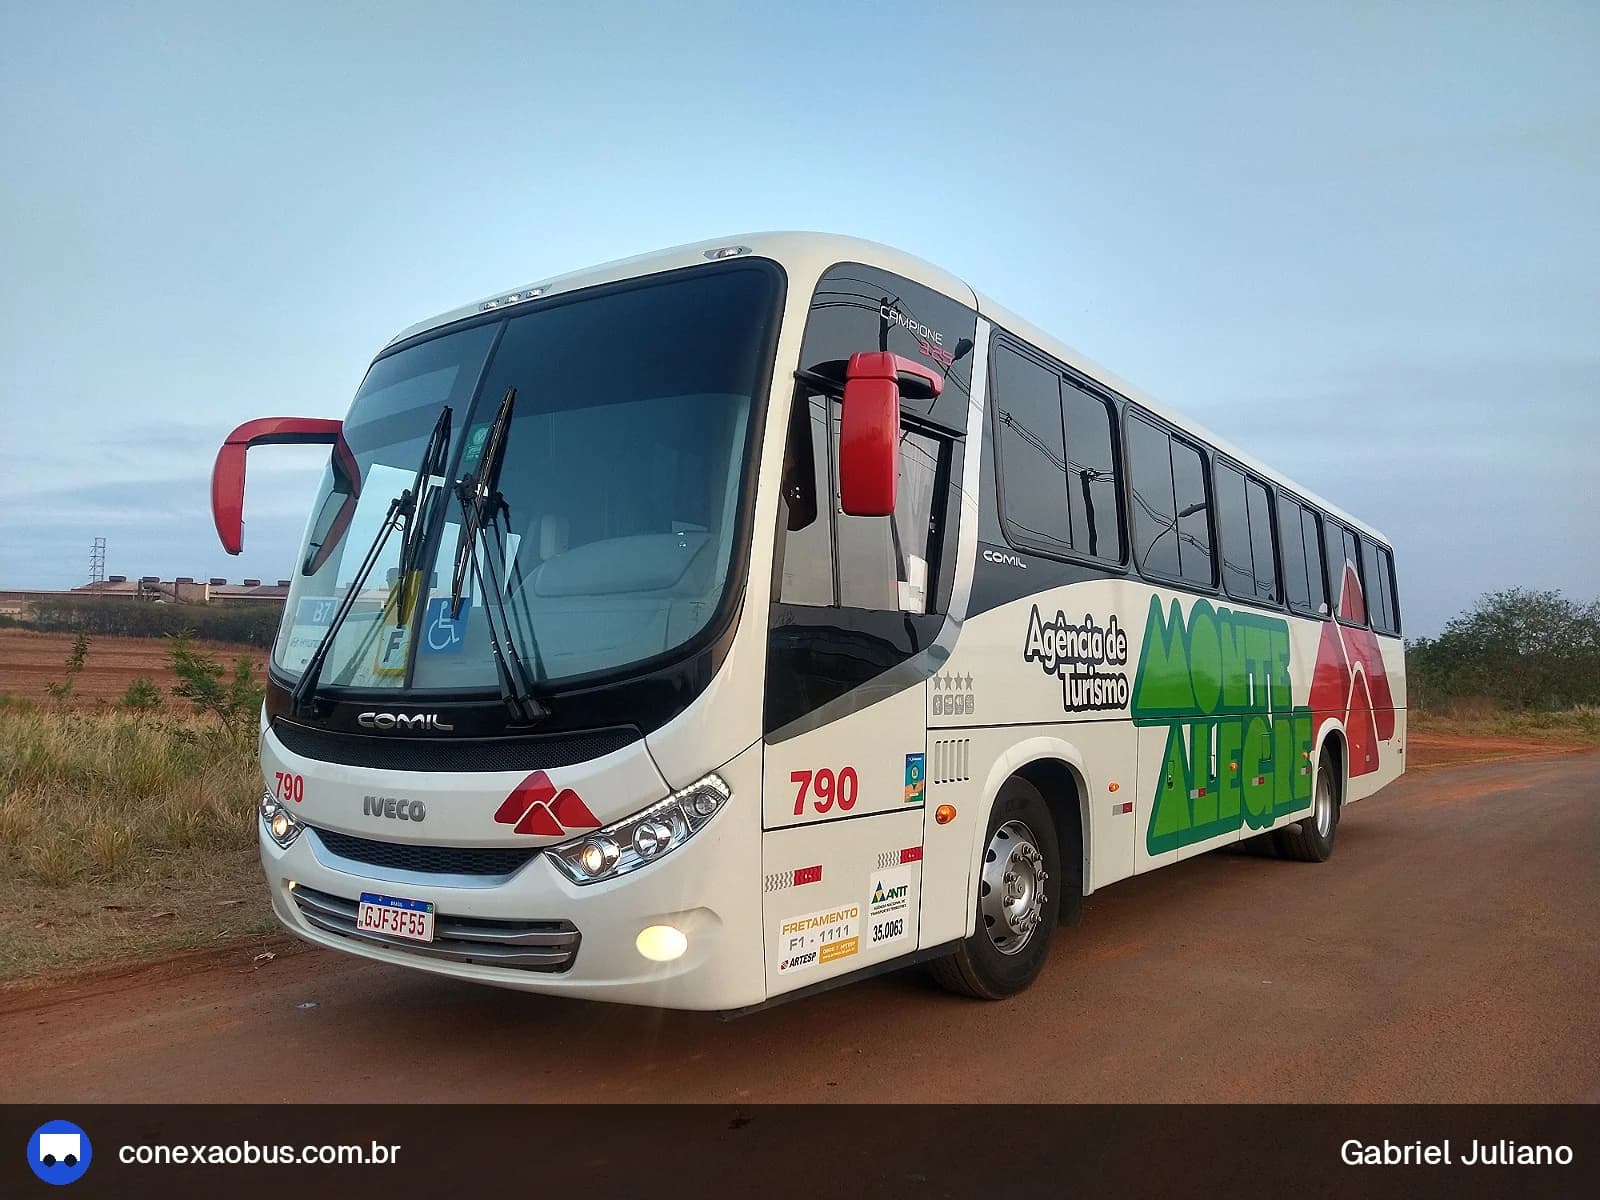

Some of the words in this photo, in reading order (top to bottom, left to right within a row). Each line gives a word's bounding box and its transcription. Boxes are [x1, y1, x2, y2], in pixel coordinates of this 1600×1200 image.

[880, 305, 943, 346] CAMPIONE
[983, 550, 1027, 569] COMIL
[383, 630, 405, 663] F
[1024, 604, 1104, 674] Agência
[1105, 614, 1127, 665] de
[1131, 594, 1292, 718] MONTE
[1058, 663, 1129, 712] Turismo
[358, 712, 454, 731] COMIL
[275, 771, 304, 803] 790
[790, 766, 858, 816] 790
[1147, 706, 1312, 854] ALEGRE
[363, 795, 426, 822] IVECO
[886, 885, 908, 901] ANTT
[364, 906, 426, 936] GJF3F55
[782, 907, 858, 936] FRETAMENTO
[872, 918, 904, 943] 35.0063
[789, 936, 805, 951] F1
[819, 924, 849, 943] 1111
[788, 951, 817, 969] ARTESP
